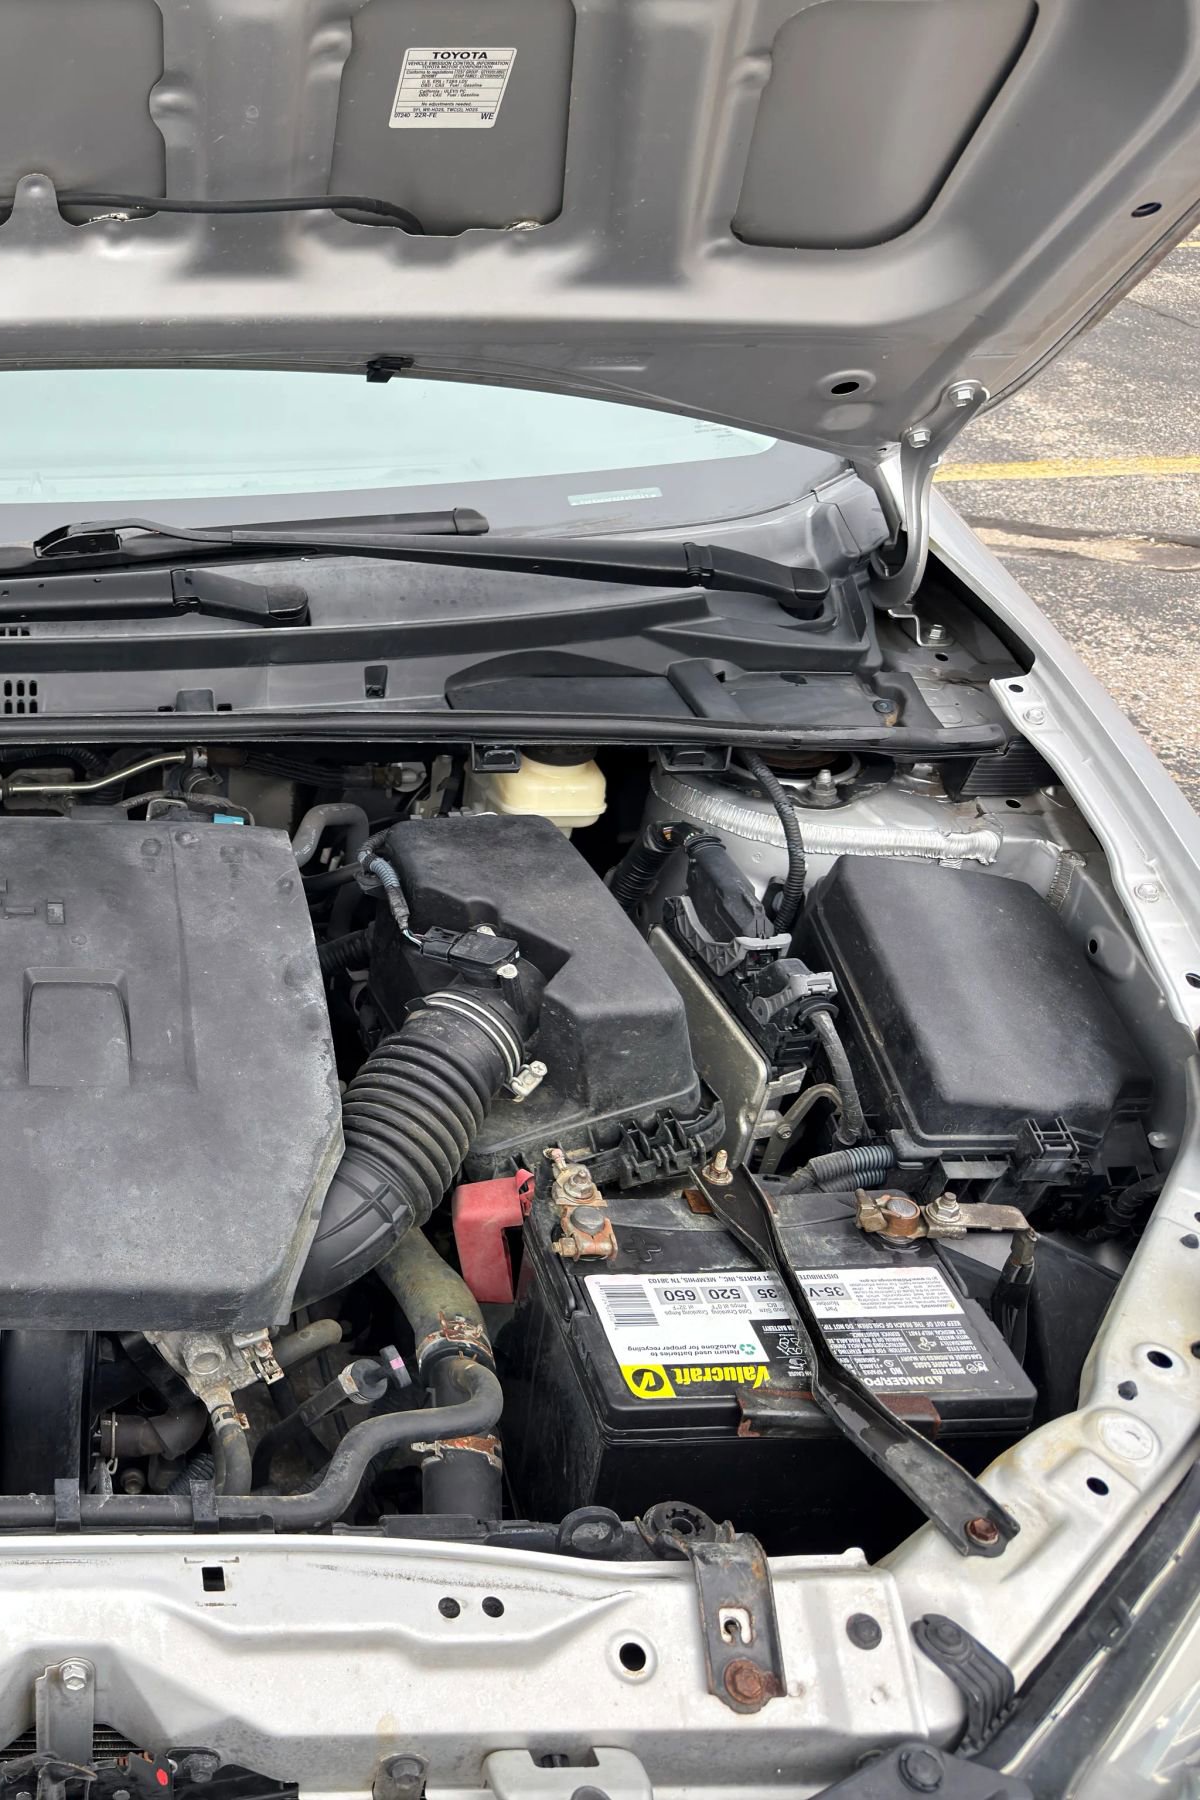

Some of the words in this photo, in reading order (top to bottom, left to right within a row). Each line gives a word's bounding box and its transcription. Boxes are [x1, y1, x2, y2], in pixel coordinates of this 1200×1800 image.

[432, 51, 488, 60] TOYOTA
[480, 112, 495, 120] WE
[663, 1289, 696, 1302] 650
[708, 1288, 741, 1300] 520
[756, 1288, 778, 1299] 35
[711, 1308, 737, 1316] Cranking
[889, 1367, 904, 1375] NO
[675, 1366, 770, 1389] Valucraft
